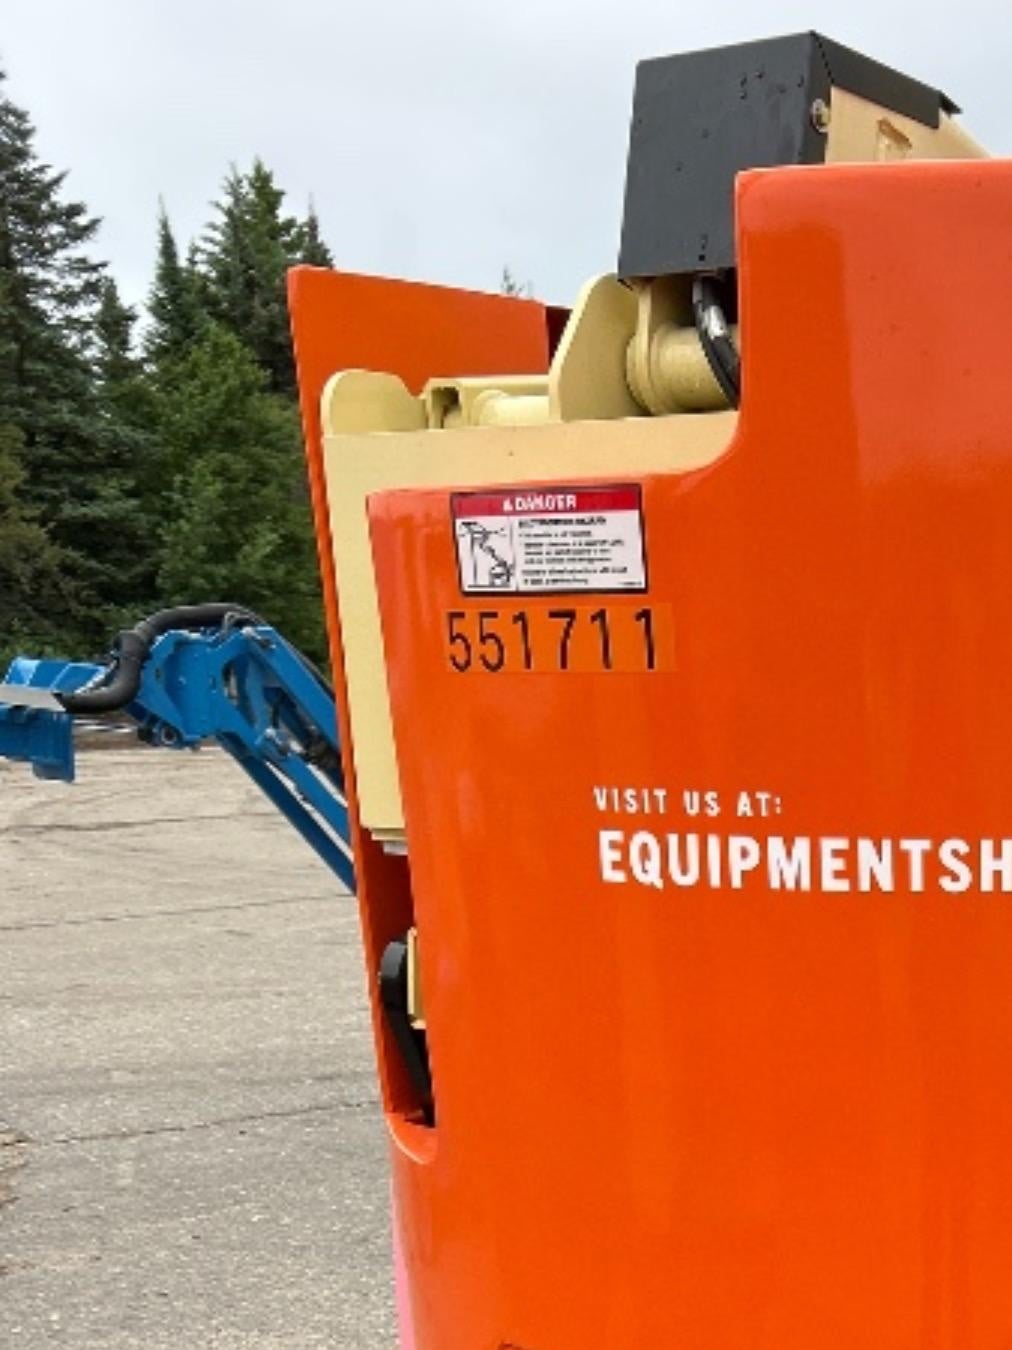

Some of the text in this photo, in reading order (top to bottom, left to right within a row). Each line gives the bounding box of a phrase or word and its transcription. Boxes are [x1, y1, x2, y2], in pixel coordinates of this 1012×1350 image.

[515, 494, 577, 511] DANGER
[447, 608, 655, 672] 551711
[593, 786, 783, 817] VISIT US AT:
